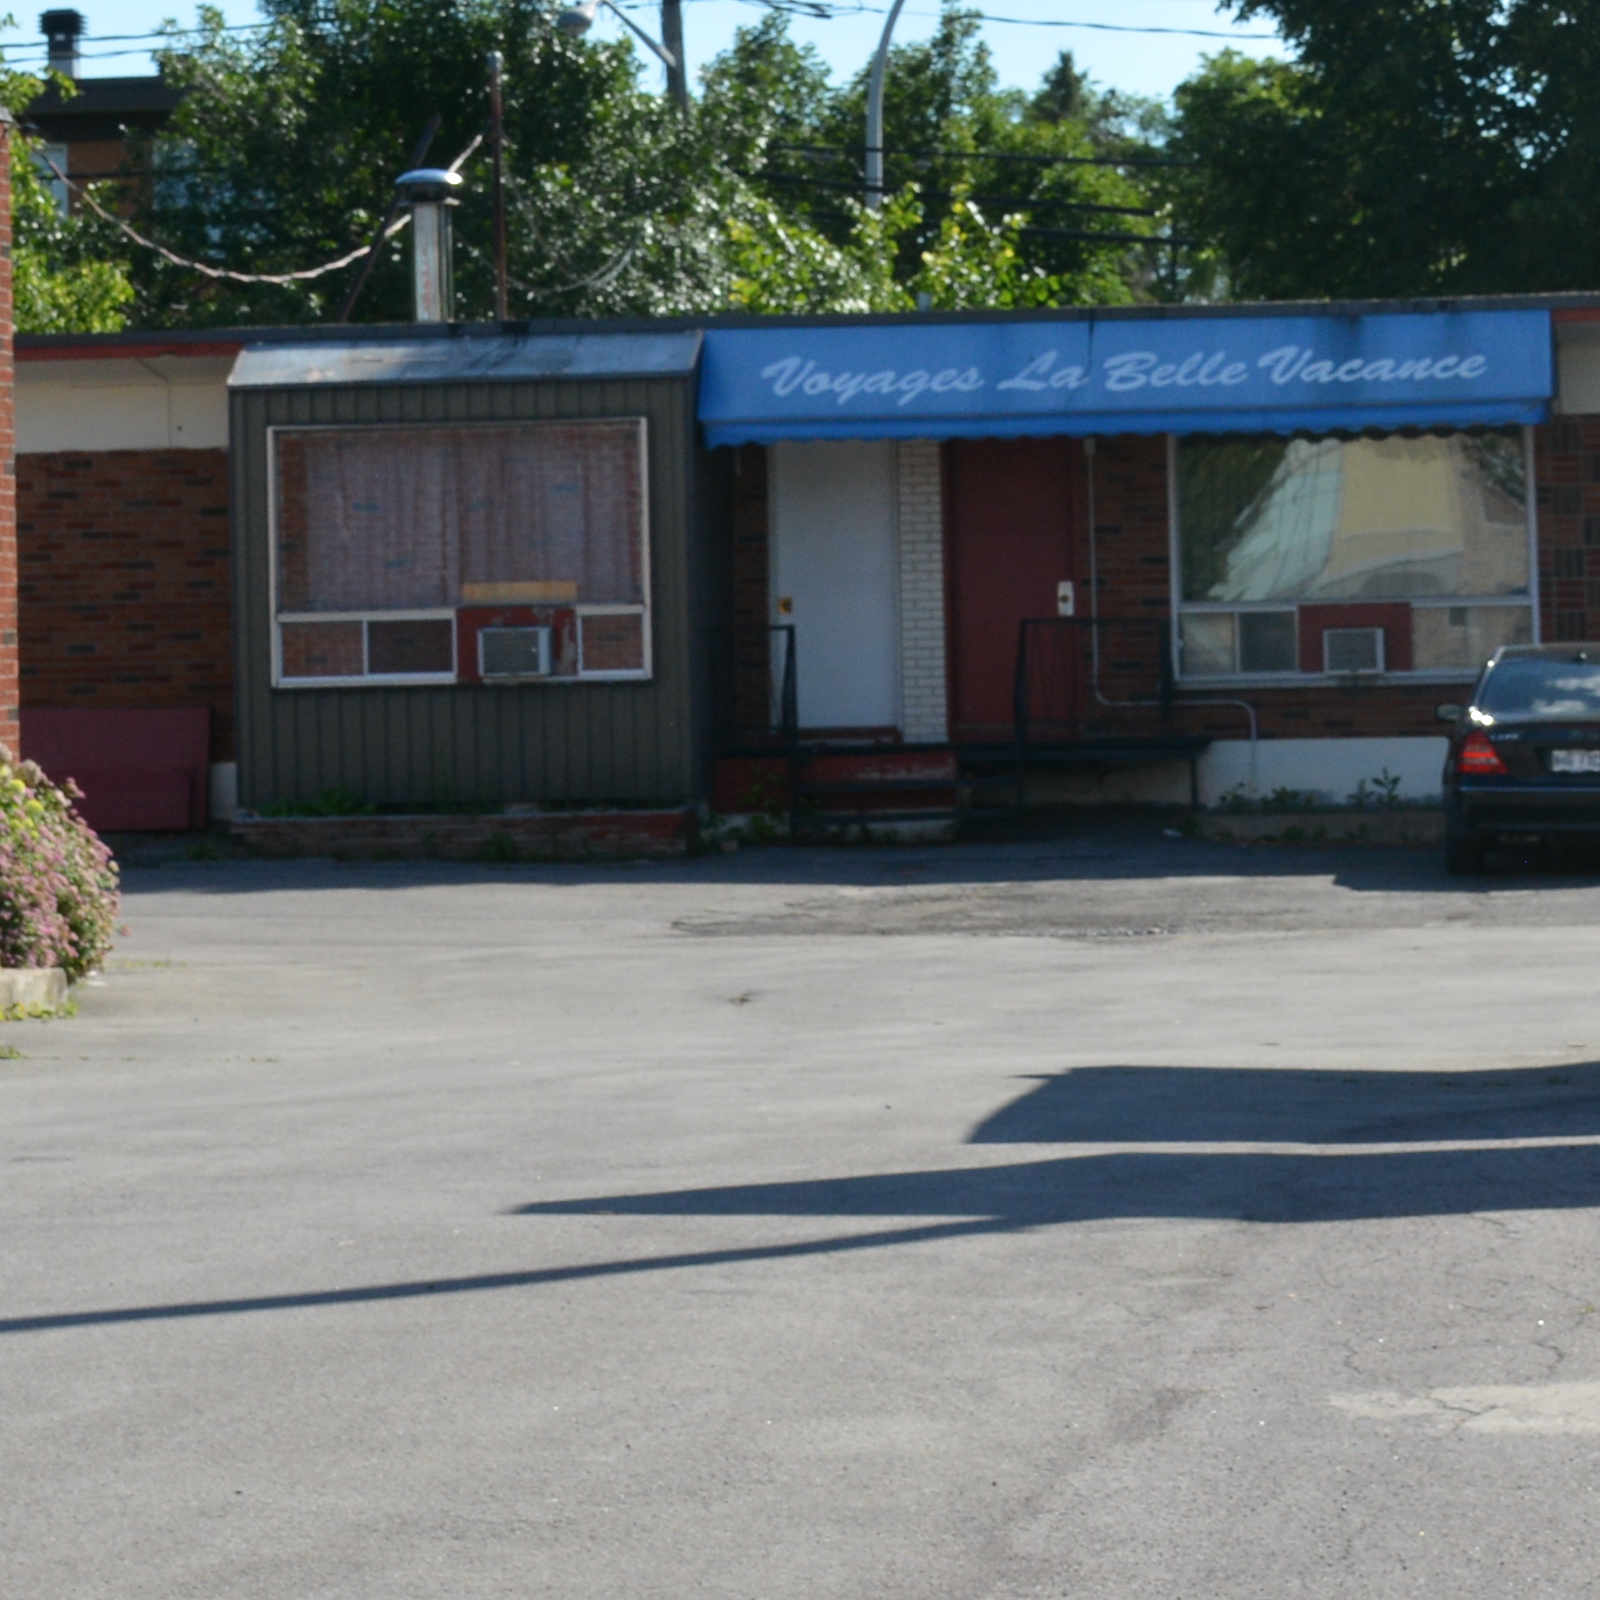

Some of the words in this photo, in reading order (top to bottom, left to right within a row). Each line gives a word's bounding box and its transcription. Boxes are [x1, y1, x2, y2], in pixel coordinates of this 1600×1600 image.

[760, 356, 984, 405] Voyages
[997, 349, 1090, 390] La
[1103, 350, 1250, 392] Belle
[1257, 344, 1487, 385] Vacance
